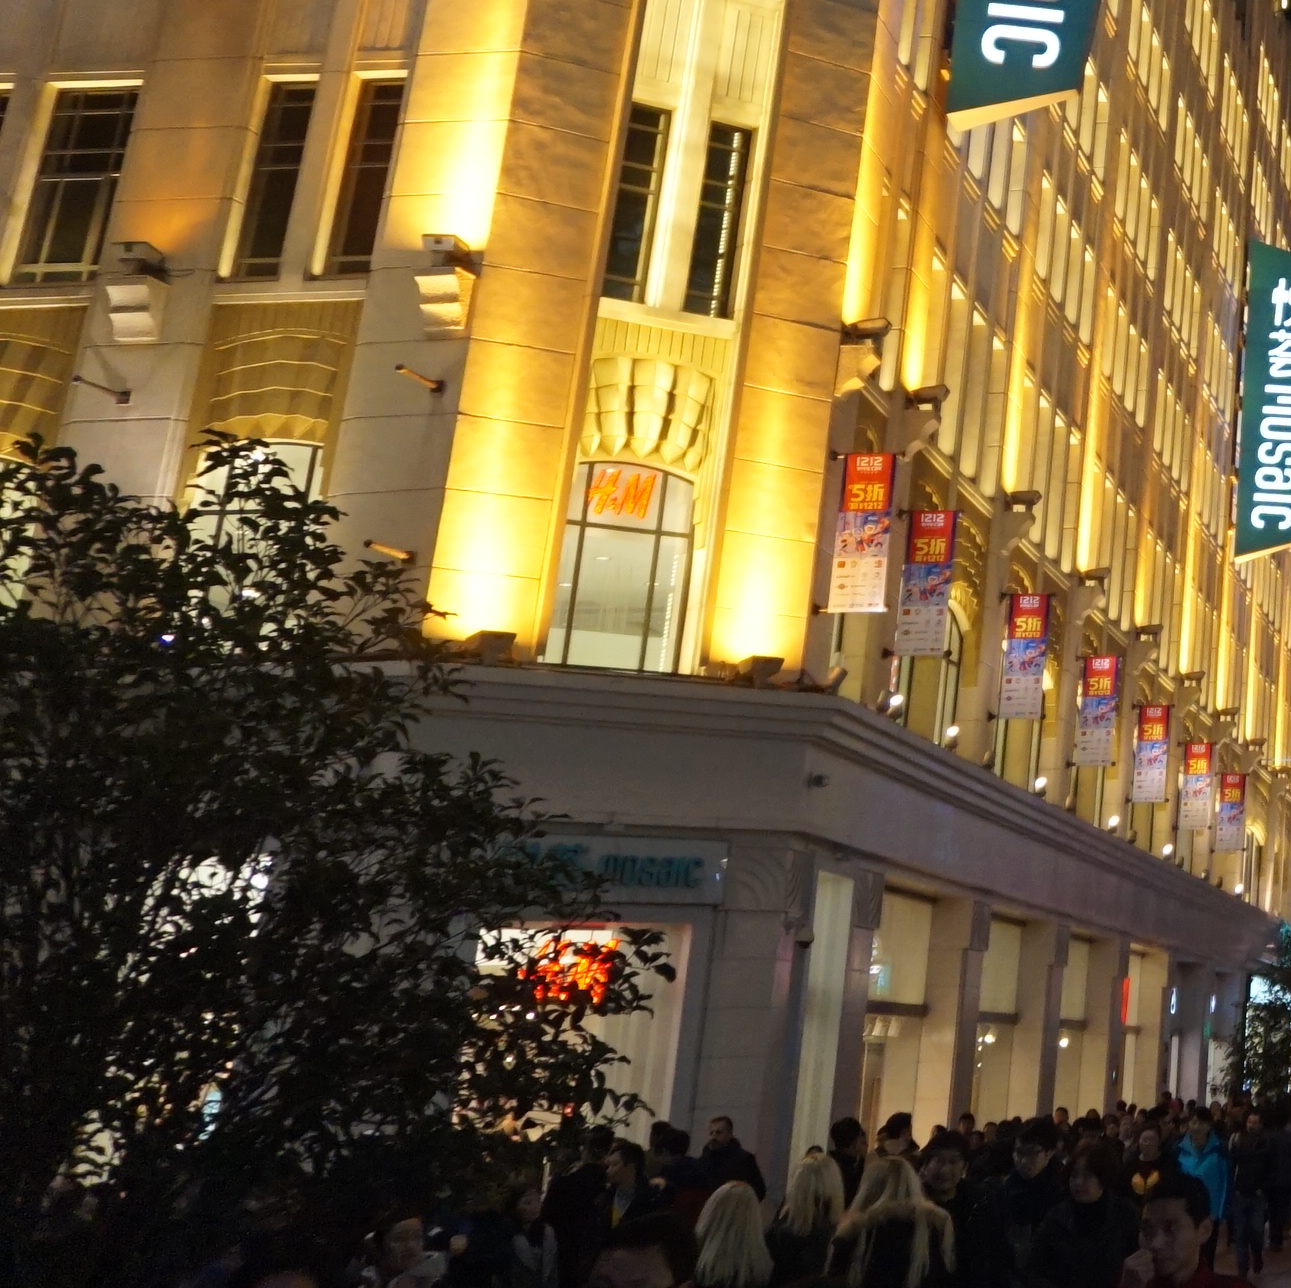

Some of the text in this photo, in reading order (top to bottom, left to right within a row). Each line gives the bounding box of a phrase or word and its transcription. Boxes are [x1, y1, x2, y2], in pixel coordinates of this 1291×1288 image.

[857, 457, 883, 466] 1212
[587, 469, 658, 520] H&M
[850, 484, 885, 501] 5折
[921, 514, 945, 523] 1212
[916, 539, 946, 555] 5折
[1020, 596, 1040, 604] 1212
[1092, 658, 1110, 666] 1212
